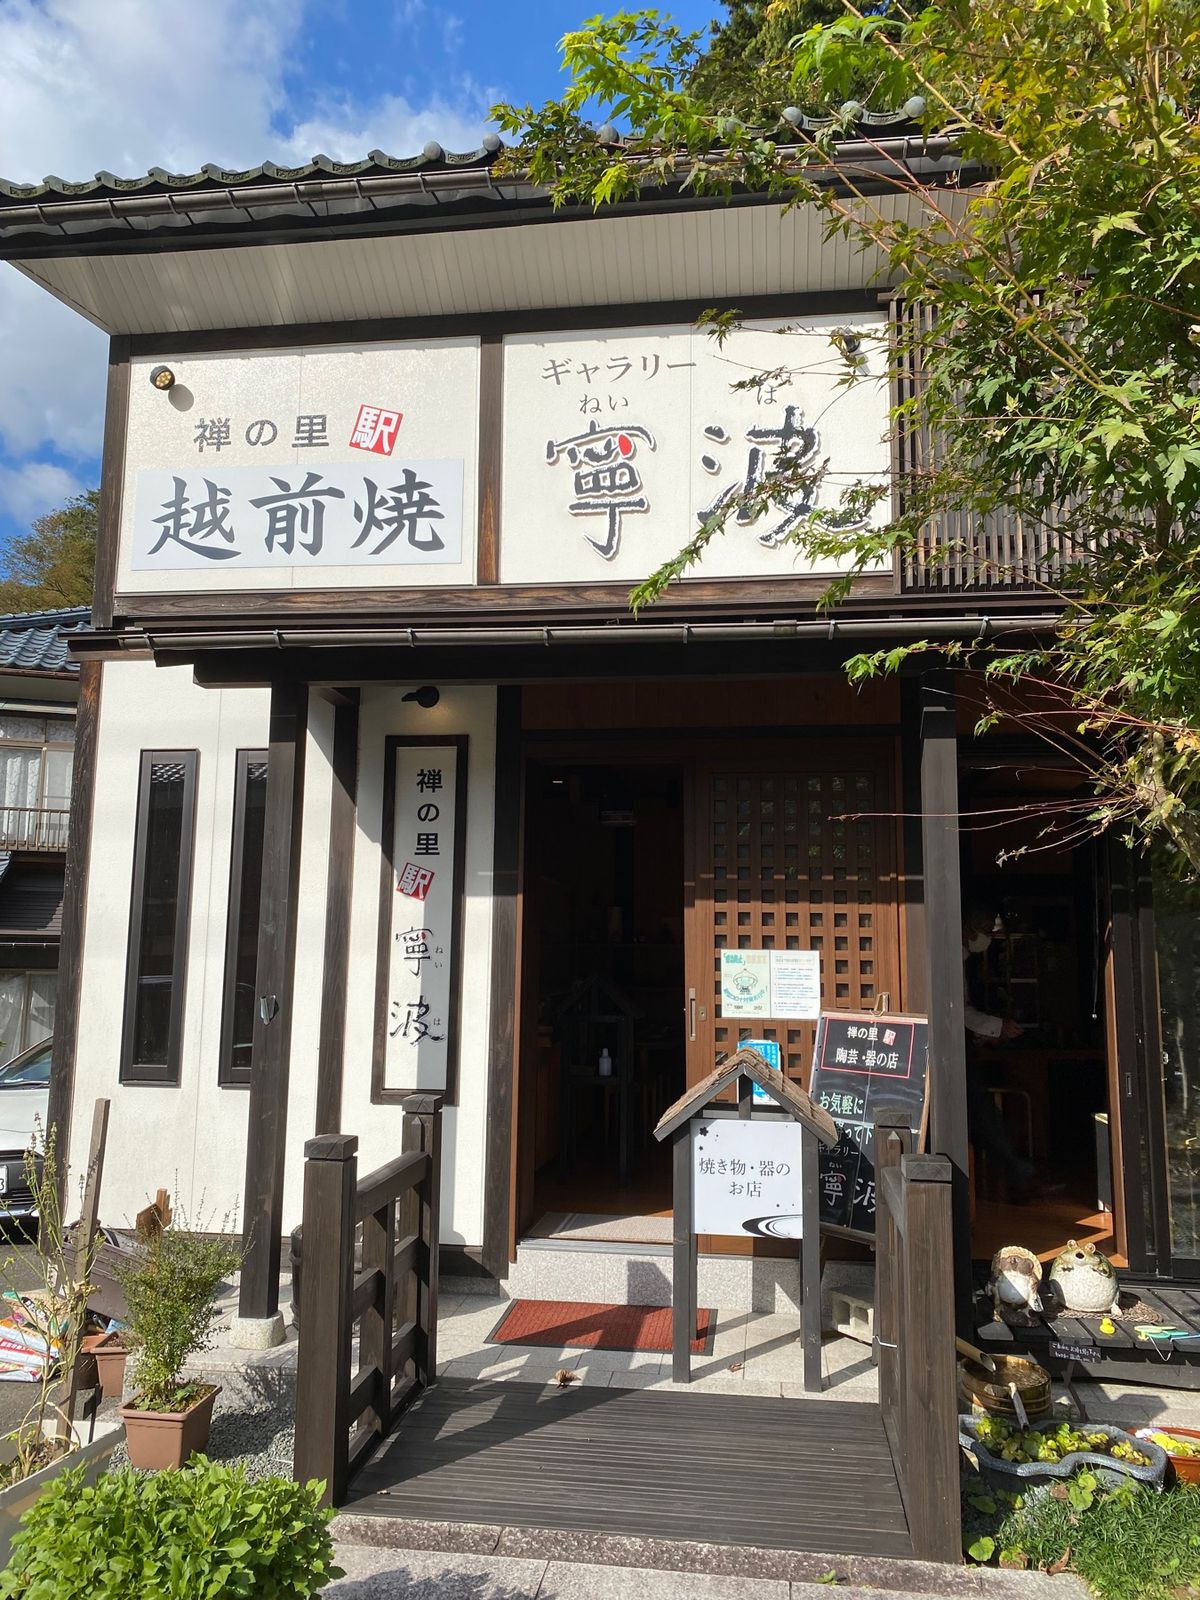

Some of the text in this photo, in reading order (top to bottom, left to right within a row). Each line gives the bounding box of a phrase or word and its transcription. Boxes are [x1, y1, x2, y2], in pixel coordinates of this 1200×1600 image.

[542, 353, 697, 385] ギャラリー
[579, 393, 629, 414] ねい
[756, 381, 778, 405] は
[194, 404, 403, 456] 禅の里 駅
[545, 404, 872, 561] 寧波
[147, 468, 446, 560] 越前焼
[396, 768, 443, 902] 禅の里 駅
[389, 926, 446, 1047] 寧波
[433, 1017, 442, 1026] は
[847, 1025, 879, 1041] 禅の里
[835, 1047, 899, 1070] 陶芸・器の店
[820, 1091, 864, 1115] お気軽に
[699, 1157, 791, 1177] 焼き物・器の
[729, 1180, 762, 1198] お店
